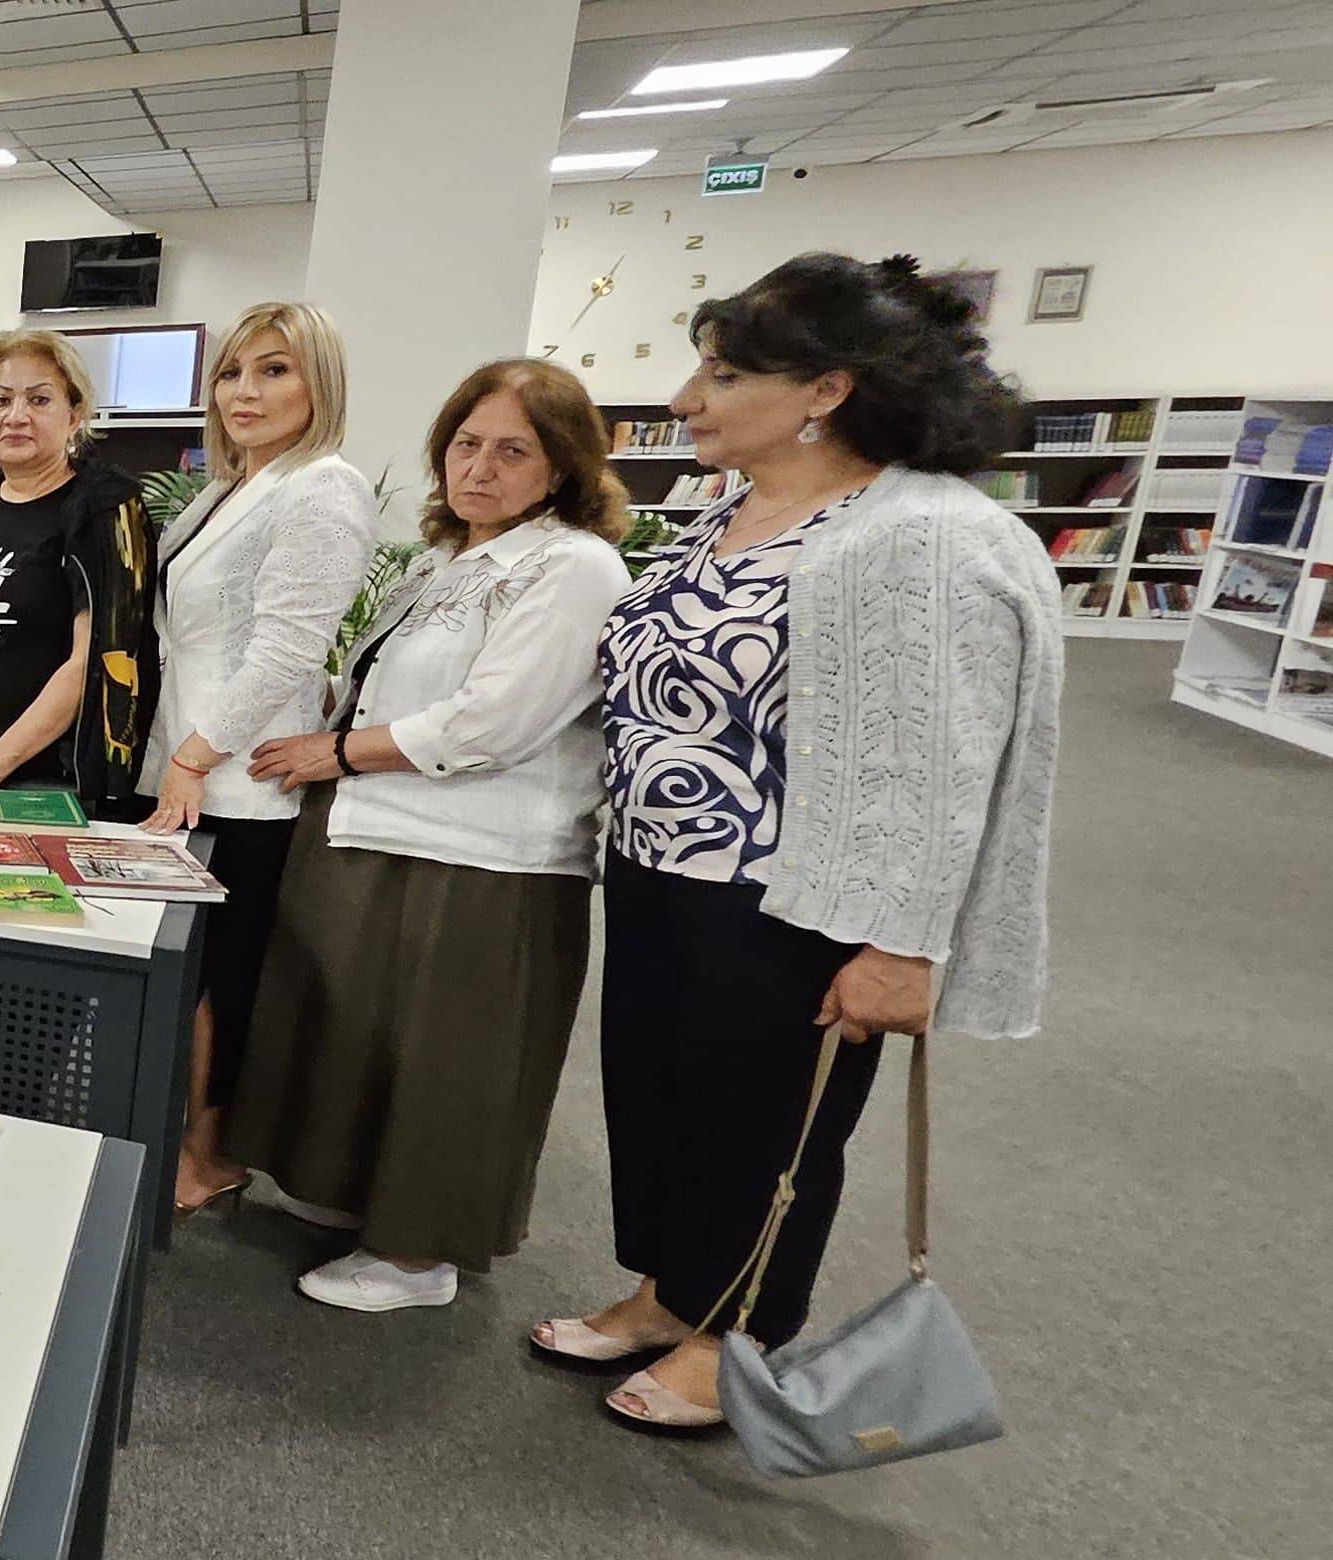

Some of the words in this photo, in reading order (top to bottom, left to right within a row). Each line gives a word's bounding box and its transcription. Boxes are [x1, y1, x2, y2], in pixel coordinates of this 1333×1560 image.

[609, 201, 634, 216] 12
[554, 215, 570, 230] 11
[662, 209, 672, 224] 1
[685, 235, 704, 250] 2
[690, 273, 707, 289] 3
[542, 345, 559, 359] 7
[634, 343, 651, 359] 5
[581, 353, 596, 368] 6
